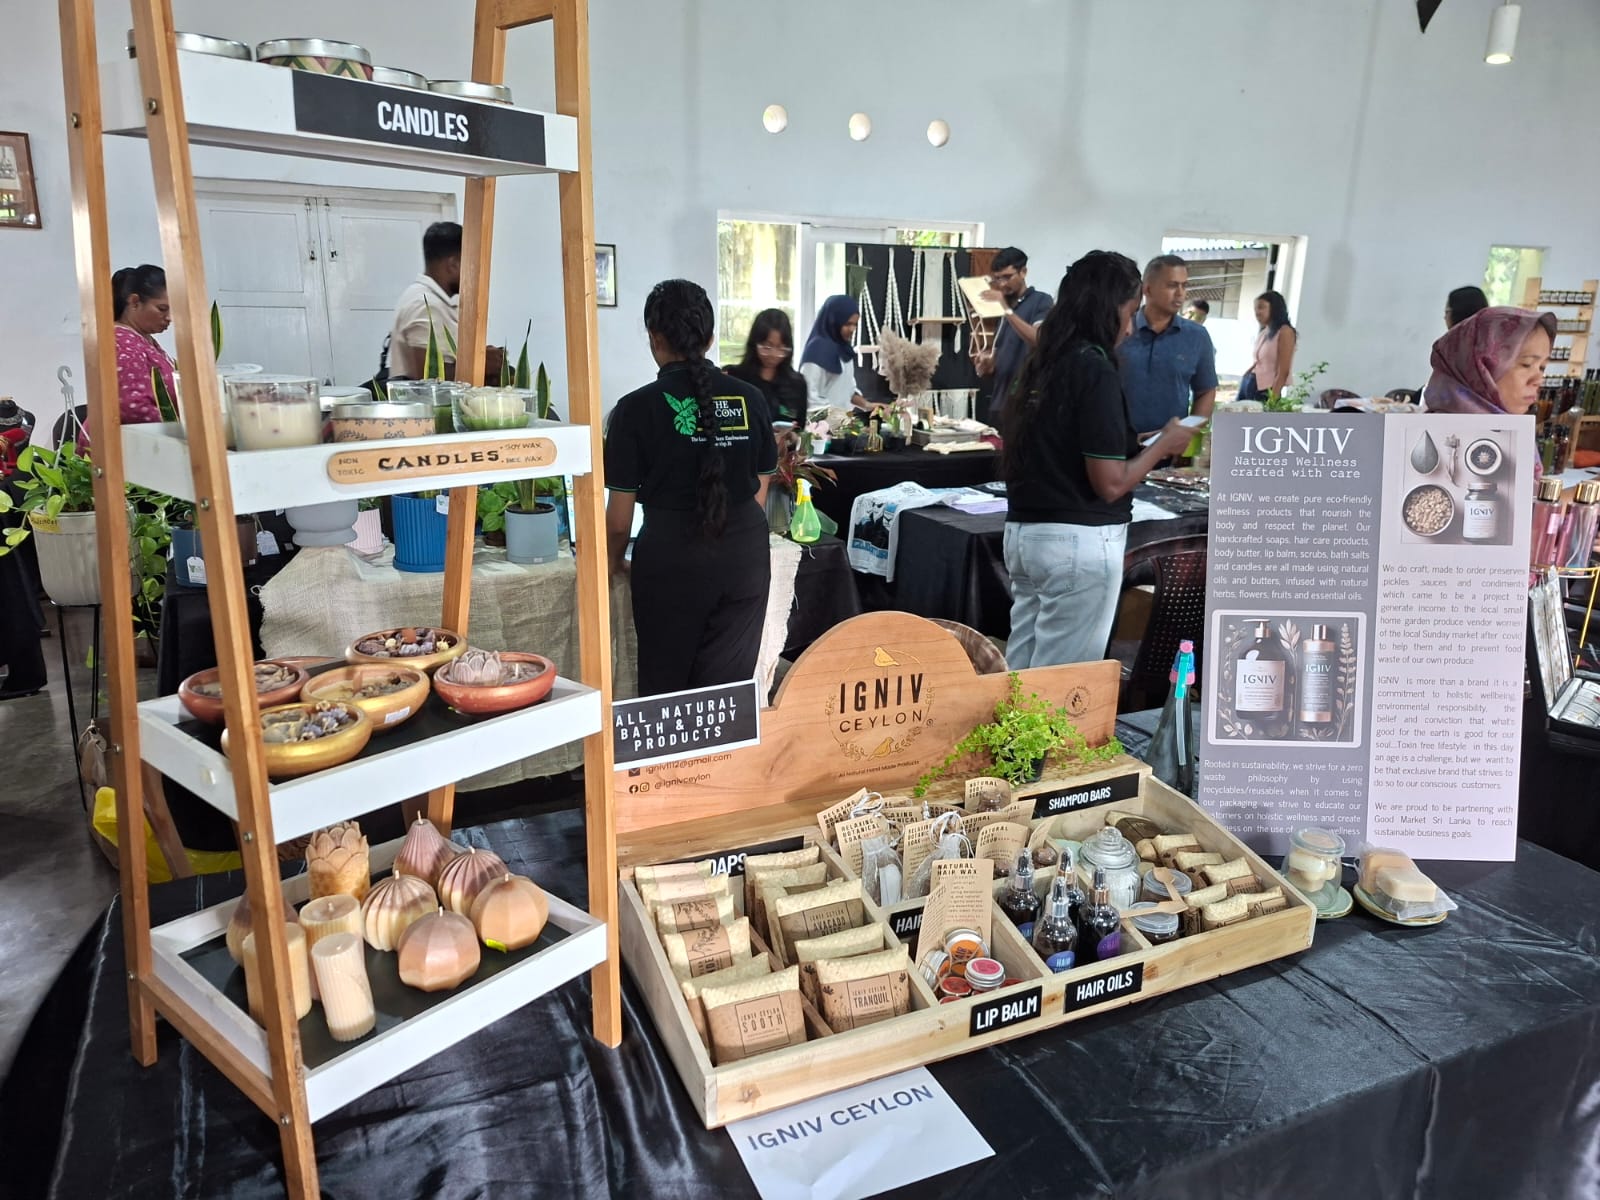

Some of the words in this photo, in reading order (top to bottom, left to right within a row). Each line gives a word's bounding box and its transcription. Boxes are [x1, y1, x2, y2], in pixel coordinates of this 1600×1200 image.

[377, 101, 469, 142] CANDLES
[714, 408, 742, 418] CONY
[1240, 426, 1354, 455] IGNIV
[378, 450, 499, 472] CANDLES
[1235, 456, 1288, 466] Natures
[1296, 457, 1357, 467] Wellness
[1230, 467, 1284, 477] crafted
[1292, 468, 1322, 478] with
[1330, 470, 1360, 478] care
[1217, 492, 1226, 502] At
[1258, 495, 1270, 503] we
[1274, 494, 1300, 503] create
[1303, 495, 1322, 506] pure
[1326, 494, 1372, 507] eco-friendly
[1216, 507, 1250, 517] wellness
[1257, 507, 1292, 520] products
[1299, 508, 1316, 518] that
[1322, 508, 1352, 518] nourish
[1359, 508, 1372, 519] the
[1215, 520, 1235, 533] body
[1243, 520, 1258, 531] and
[1265, 522, 1295, 534] respect
[1302, 521, 1315, 531] the
[1356, 522, 1370, 532] Our
[1215, 534, 1263, 545] handcrafted
[1294, 535, 1309, 545] hair
[1313, 538, 1330, 546] care
[1214, 548, 1234, 560] body
[1264, 548, 1274, 561] lip
[1330, 549, 1349, 560] bath
[1351, 550, 1370, 560] salts
[1214, 561, 1230, 572] and
[1231, 562, 1262, 572] candles
[1264, 564, 1278, 572] are
[1280, 562, 1290, 572] all
[1292, 563, 1315, 573] made
[1317, 564, 1339, 576] using
[1341, 563, 1369, 574] natural
[1213, 575, 1227, 585] oils
[1232, 575, 1247, 586] and
[1285, 576, 1315, 587] infused
[1319, 577, 1337, 587] with
[1340, 577, 1369, 588] natural
[1271, 590, 1292, 600] fruits
[1294, 590, 1310, 600] and
[1311, 590, 1346, 601] essential
[1243, 674, 1277, 684] IGNIV
[840, 673, 923, 714] IGNIV
[615, 711, 646, 728] ALL
[662, 696, 737, 720] NATURAL
[620, 722, 664, 740] BATH
[675, 719, 684, 731] &
[696, 710, 737, 728] BODY
[839, 710, 922, 733] CEYLON
[634, 725, 722, 751] PRODUCTS
[1204, 759, 1231, 770] Rooted
[1232, 761, 1239, 770] in
[1293, 763, 1304, 771] we
[1306, 762, 1326, 772] strive
[1328, 762, 1338, 772] for
[1340, 764, 1346, 772] a
[1347, 764, 1364, 772] zero
[1374, 765, 1384, 775] be
[1386, 765, 1401, 775] that
[1402, 765, 1436, 776] exclusive
[1438, 766, 1460, 776] brand
[1462, 766, 1476, 776] that
[1478, 768, 1503, 777] strives
[1505, 768, 1513, 777] to
[1204, 773, 1226, 782] waste
[1248, 773, 1288, 786] philosophy
[1310, 774, 1320, 786] by
[1342, 775, 1363, 787] using
[1048, 791, 1089, 810] SHAMPOO
[1090, 787, 1112, 801] BARS
[1375, 801, 1387, 811] We
[1390, 803, 1403, 811] are
[1406, 801, 1428, 814] proud
[1432, 803, 1440, 812] to
[1442, 802, 1452, 812] be
[1455, 803, 1494, 816] partnering
[1498, 803, 1514, 814] with
[1374, 814, 1395, 824] Good
[1400, 814, 1426, 824] Market
[1432, 815, 1443, 825] Sri
[1449, 815, 1472, 825] Lanka
[1477, 816, 1486, 826] to
[1491, 816, 1513, 826] reach
[1374, 826, 1415, 837] sustainable
[1417, 827, 1450, 838] business
[1076, 979, 1104, 1001] HAIR
[1106, 971, 1133, 993] OILS
[854, 992, 890, 1008] TRANQUIL
[976, 1008, 999, 1030] LIP
[1002, 995, 1037, 1022] BALM
[742, 1013, 782, 1033] SOOTH
[747, 1116, 823, 1150] IGNIV
[830, 1084, 934, 1126] CEYLON
